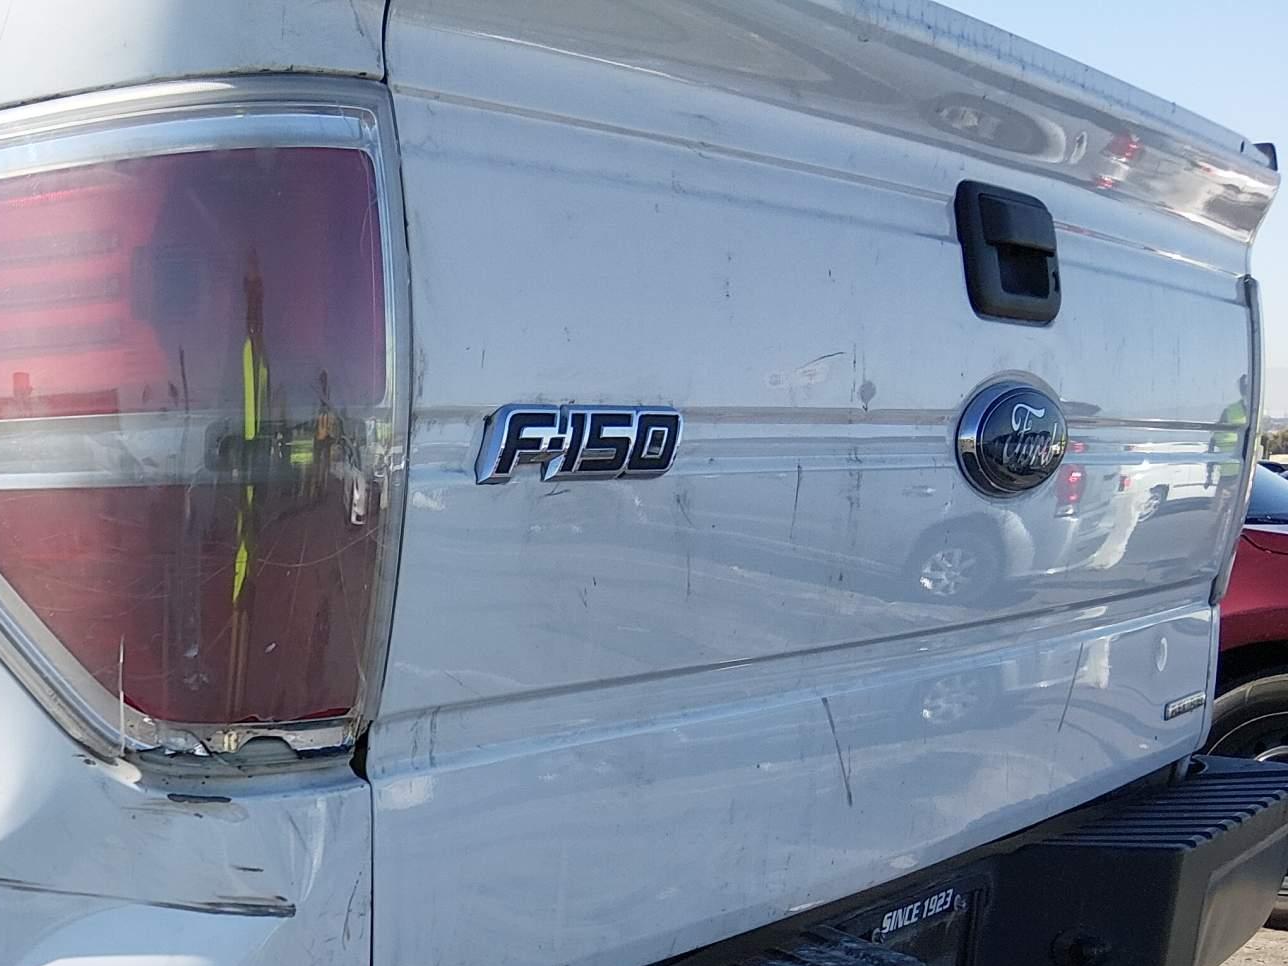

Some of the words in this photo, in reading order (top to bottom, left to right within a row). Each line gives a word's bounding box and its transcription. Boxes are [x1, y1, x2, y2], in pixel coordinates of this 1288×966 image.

[477, 404, 683, 484] F-150
[1002, 403, 1059, 466] Ford
[881, 900, 921, 933] SINCE
[922, 888, 954, 918] 1923
